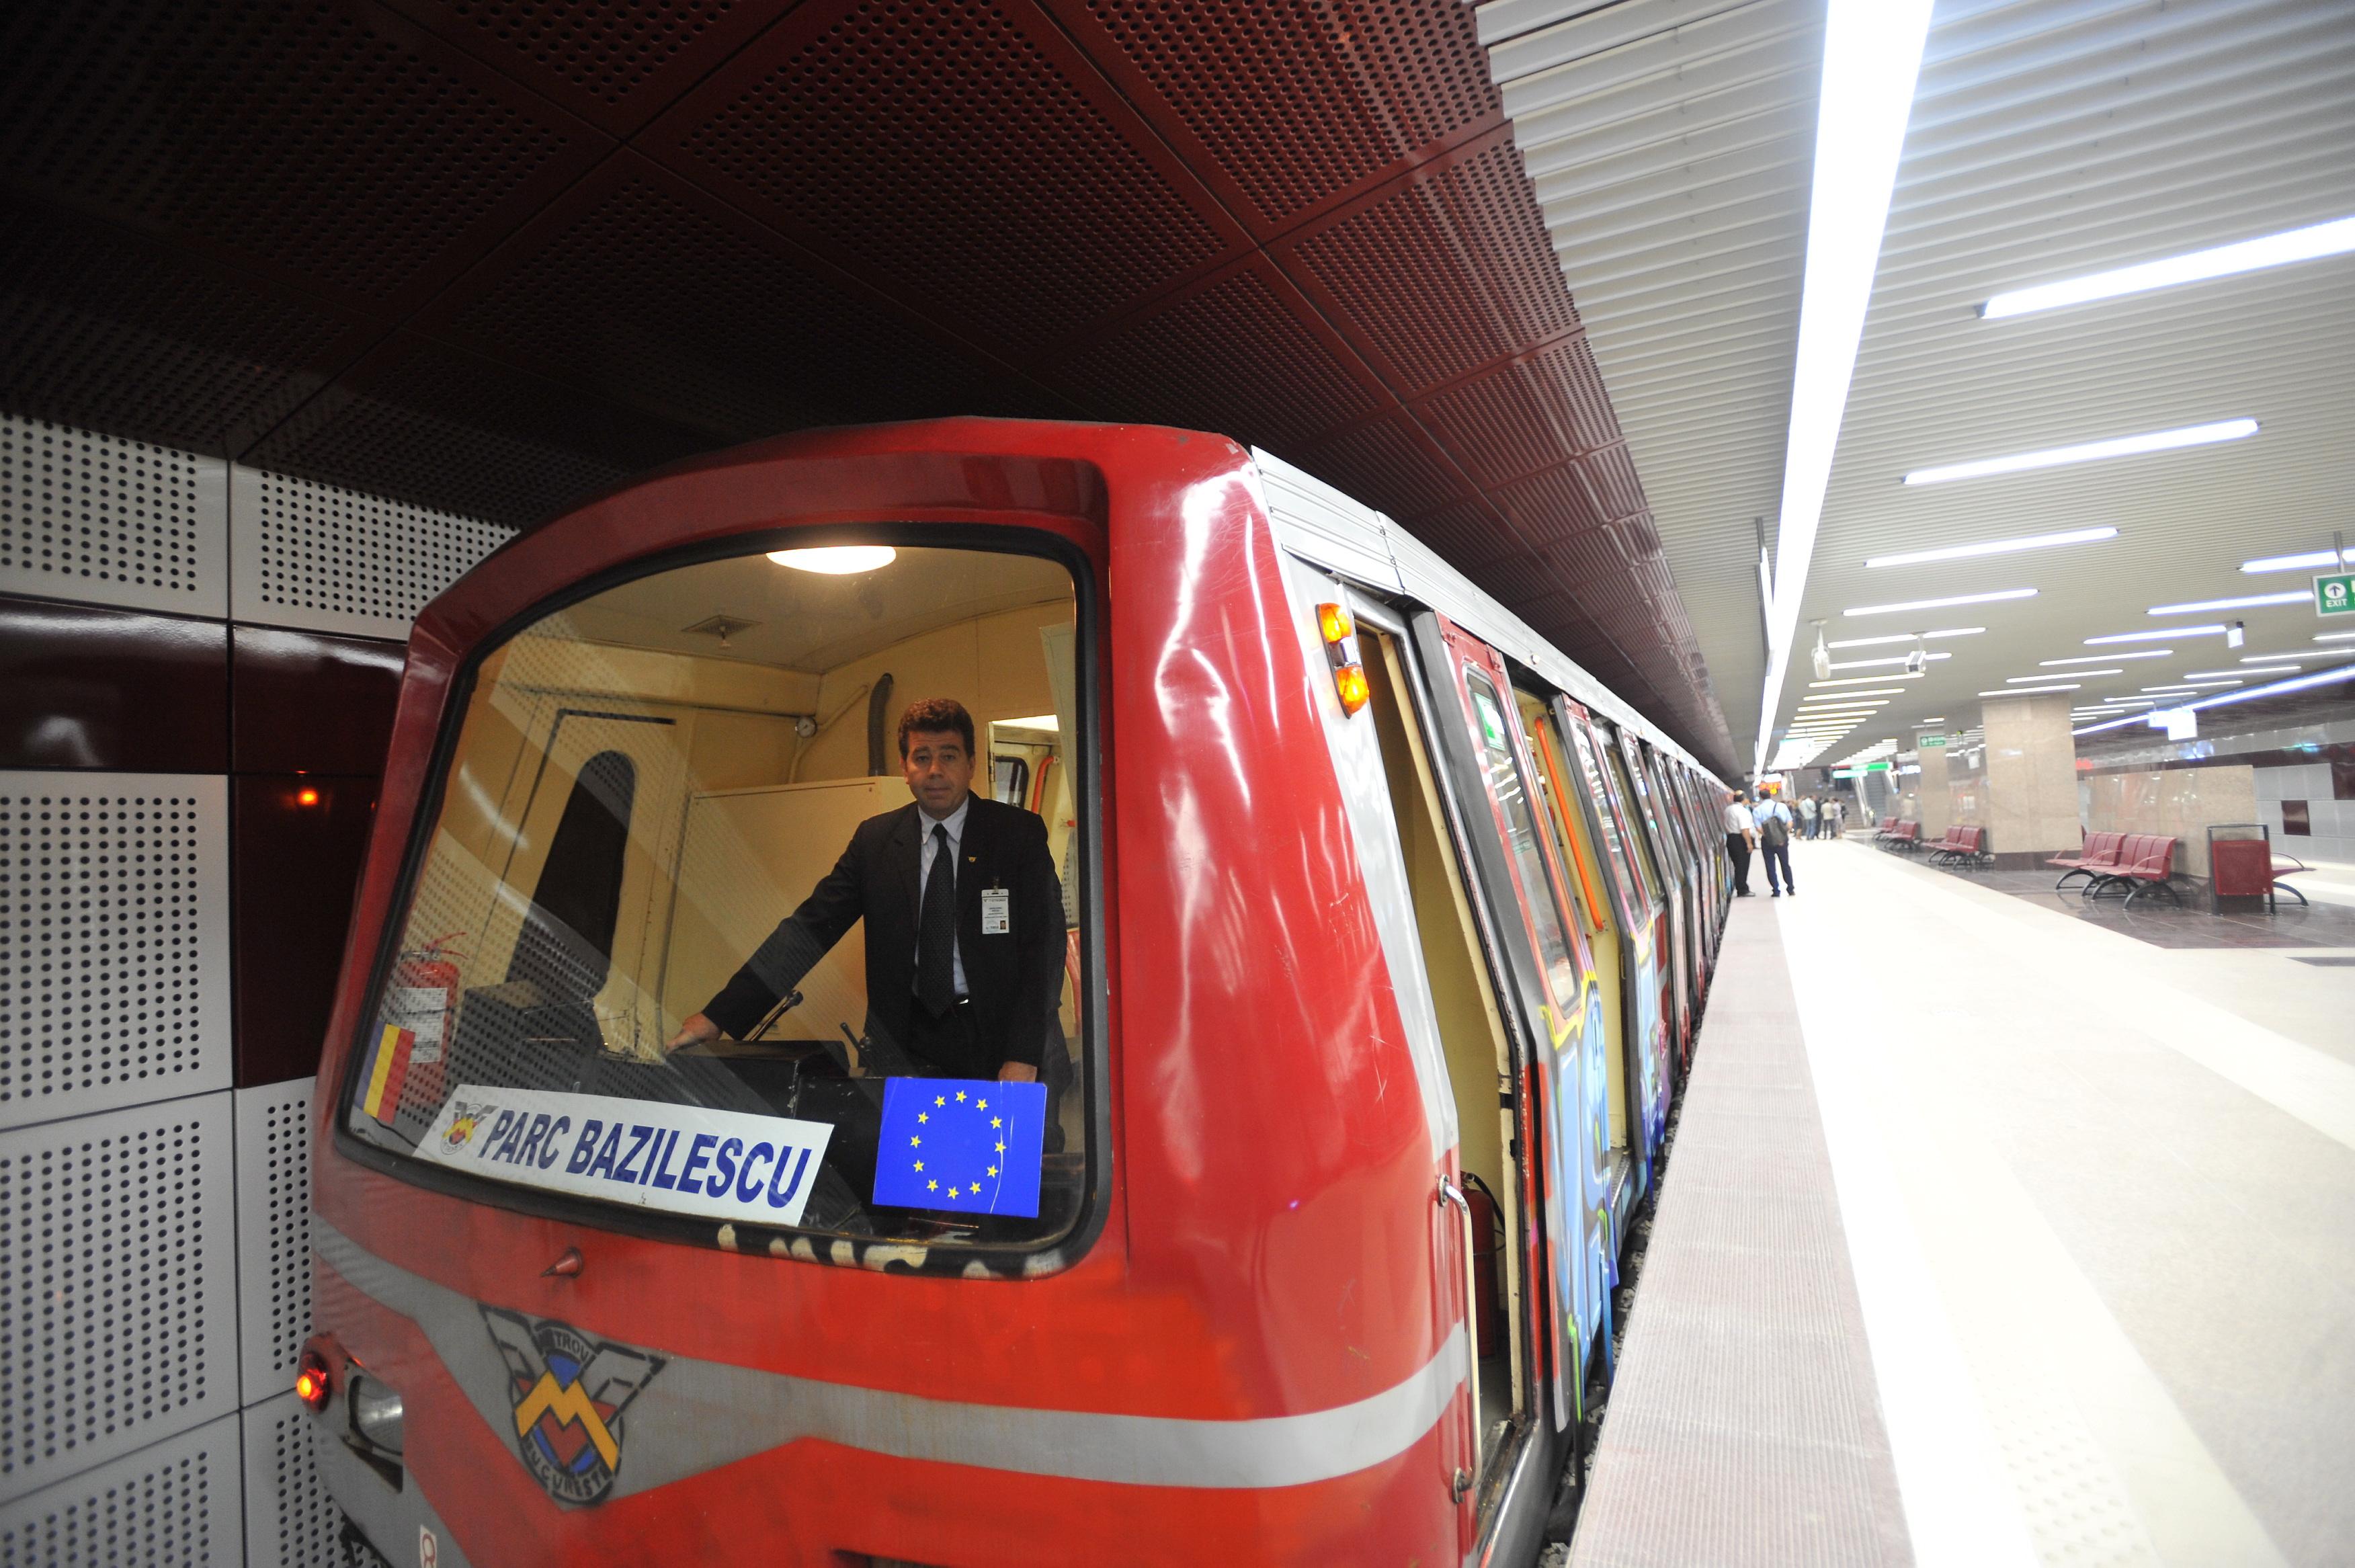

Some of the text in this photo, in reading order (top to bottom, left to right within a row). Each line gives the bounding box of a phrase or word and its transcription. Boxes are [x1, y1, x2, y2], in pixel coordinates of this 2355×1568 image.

[2325, 598, 2348, 608] EXIT
[478, 1110, 812, 1208] PARC BAZILESCU
